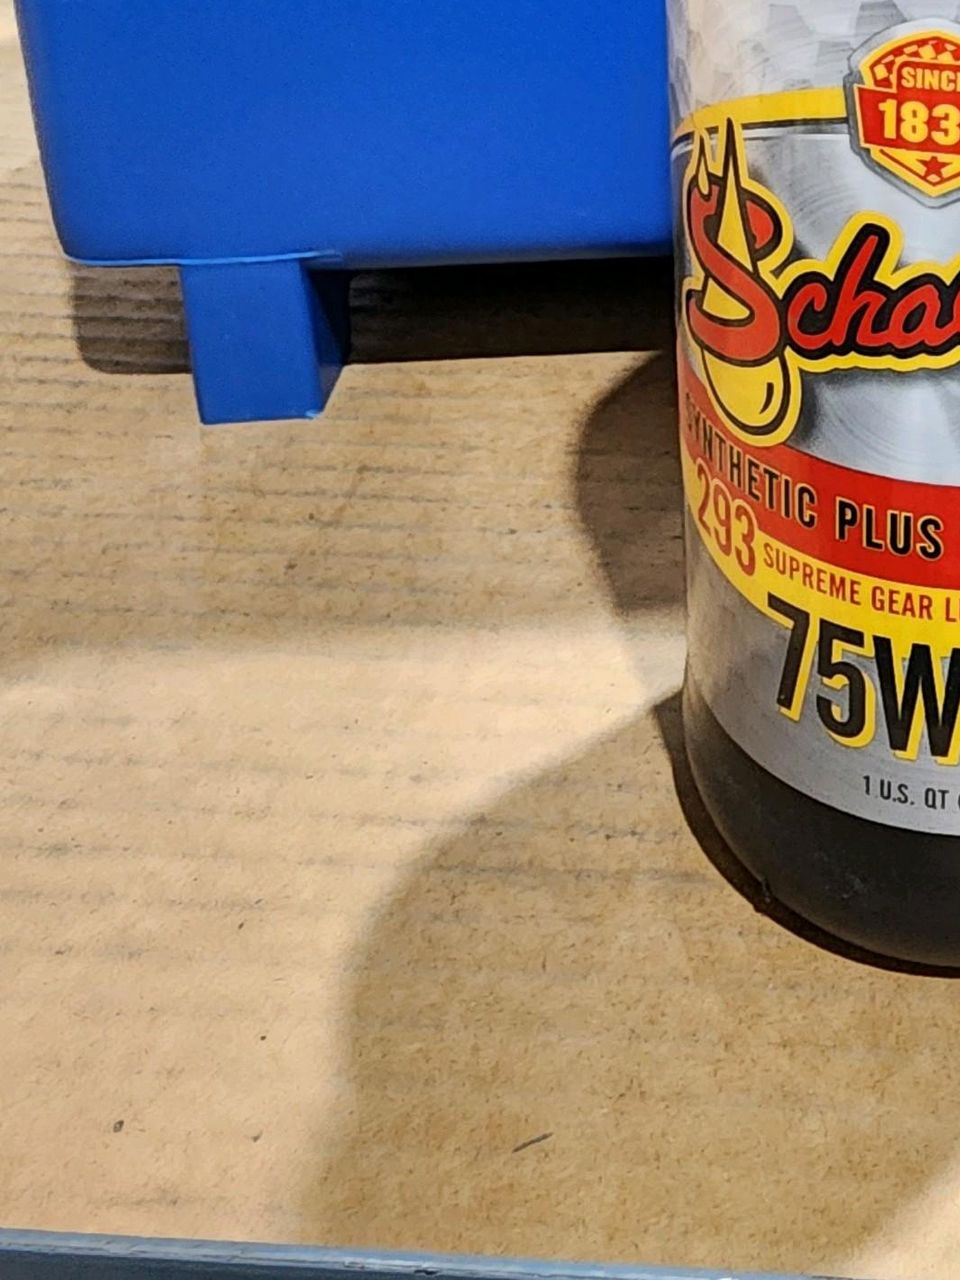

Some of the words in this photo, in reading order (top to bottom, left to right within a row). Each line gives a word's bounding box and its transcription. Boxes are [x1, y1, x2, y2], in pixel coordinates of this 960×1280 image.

[685, 391, 819, 529] SYNTHETIC
[835, 498, 943, 561] PLUS
[696, 457, 758, 578] 293
[762, 542, 863, 606] SUPREME
[870, 586, 935, 621] GEAR
[862, 773, 872, 797] 1
[878, 777, 916, 808] U.S.
[923, 786, 950, 812] QT
